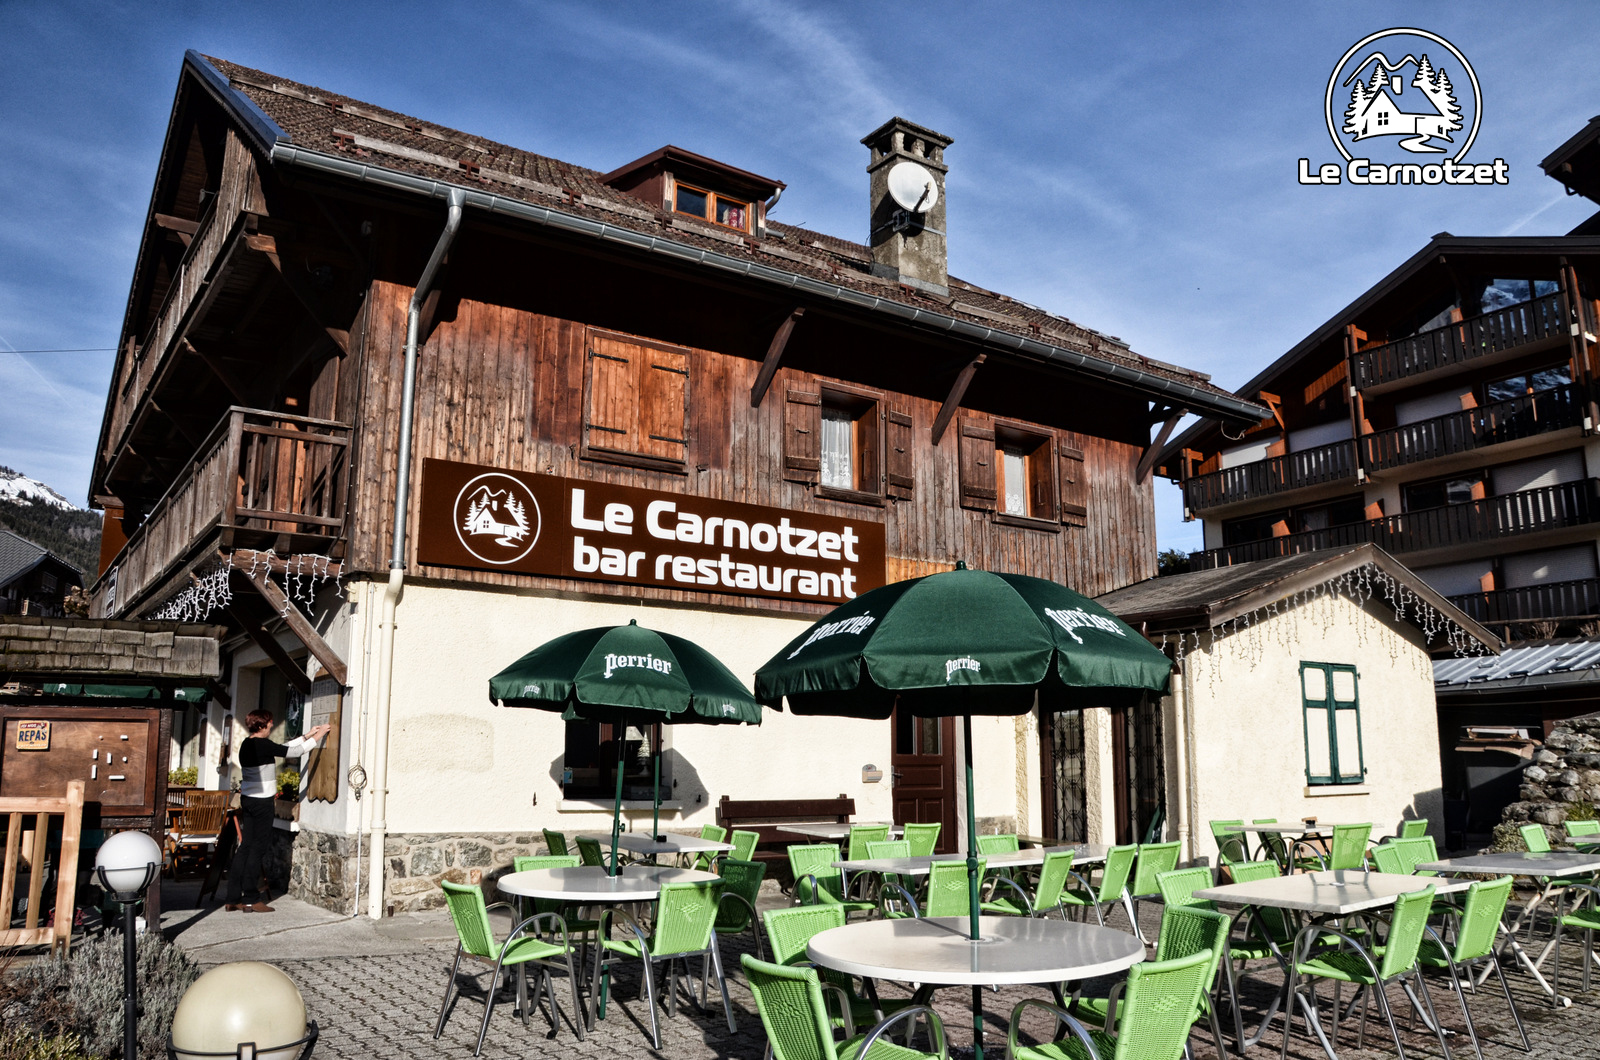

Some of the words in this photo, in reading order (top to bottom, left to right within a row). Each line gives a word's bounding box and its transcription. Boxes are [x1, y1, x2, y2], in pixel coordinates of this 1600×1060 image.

[570, 487, 634, 535] Le
[645, 499, 859, 563] Carnotzet
[573, 535, 646, 578] bar
[654, 553, 858, 600] restaurant
[18, 730, 47, 742] REPAS
